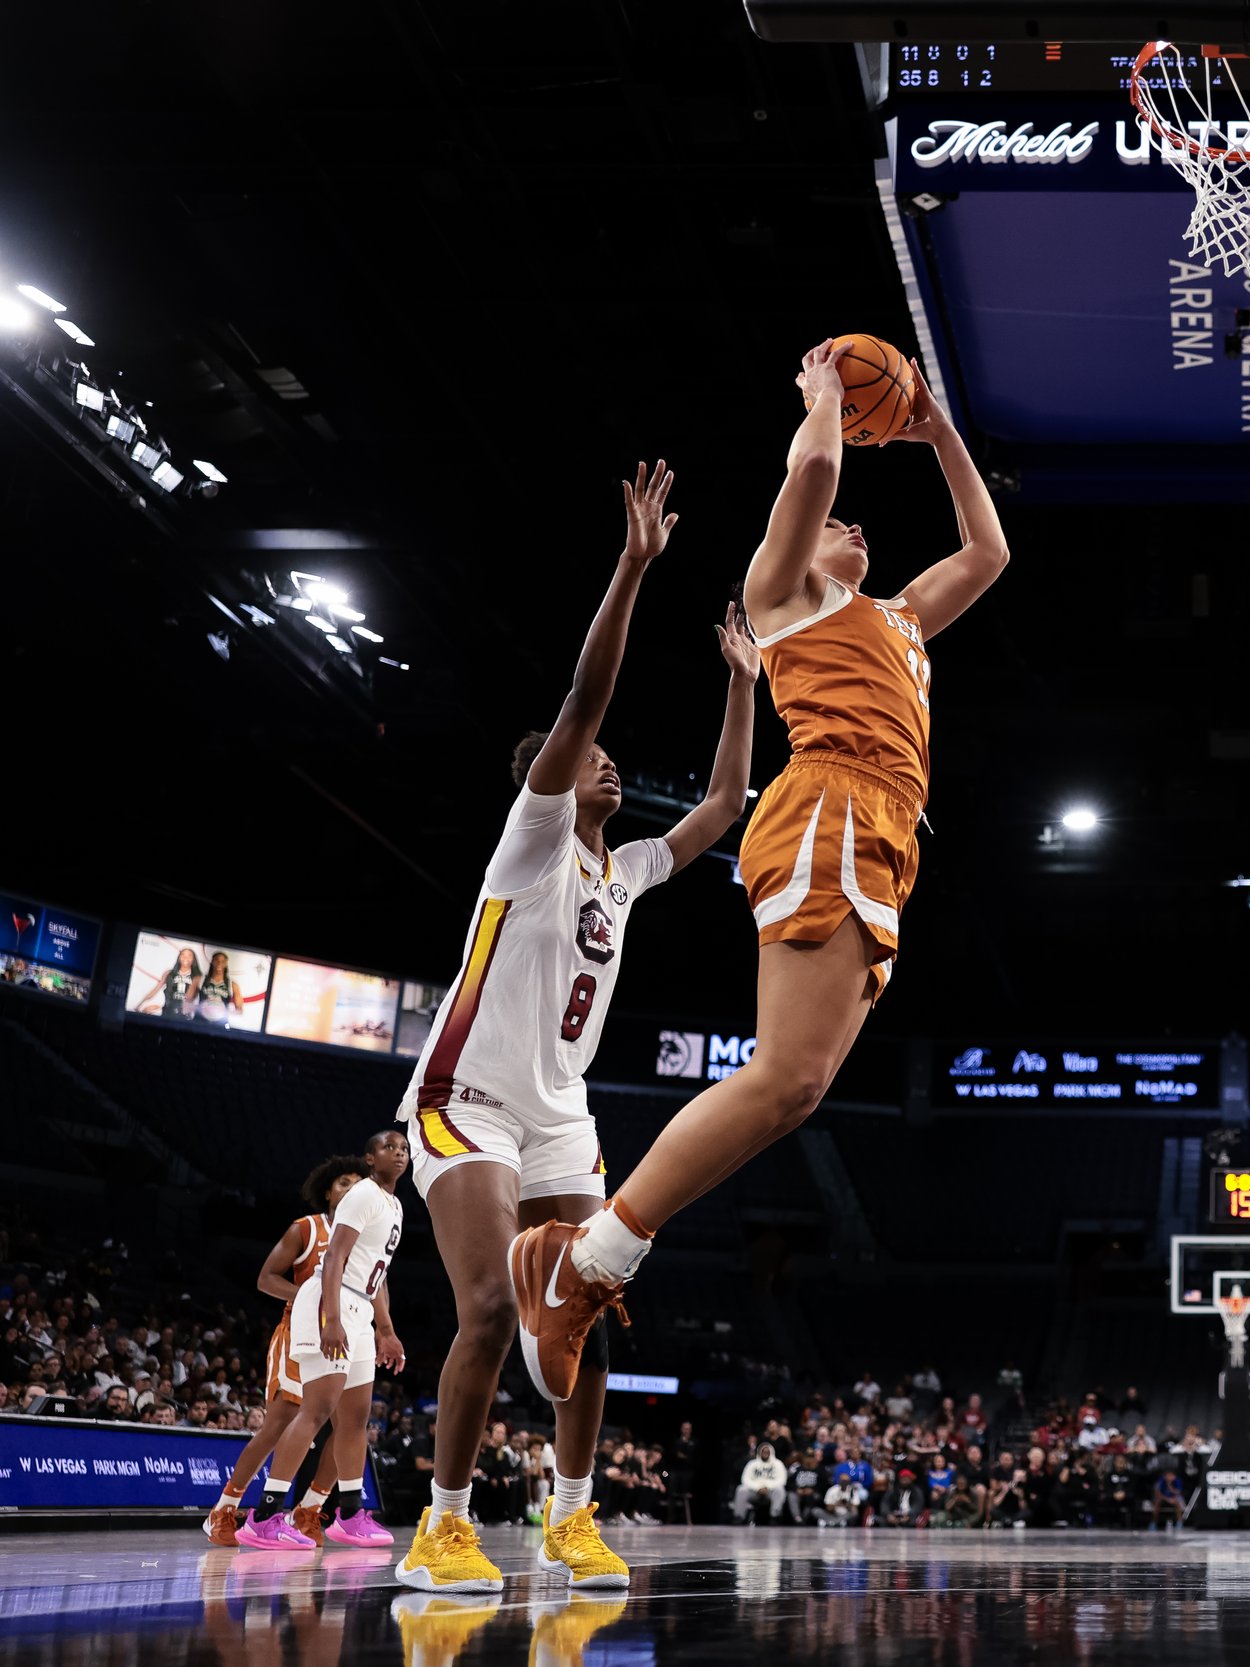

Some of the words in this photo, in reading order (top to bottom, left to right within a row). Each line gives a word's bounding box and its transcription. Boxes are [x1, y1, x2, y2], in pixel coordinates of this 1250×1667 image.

[900, 69, 922, 87] 35
[928, 69, 939, 87] 8
[980, 70, 992, 87] 2
[911, 119, 1099, 165] Michelob
[1168, 258, 1214, 370] ARENA
[610, 884, 628, 905] SEC
[560, 972, 597, 1043] 8
[460, 1087, 471, 1102] 4
[473, 1088, 487, 1099] THE
[471, 1096, 505, 1108] CULTURE
[20, 1456, 31, 1472] W
[35, 1457, 55, 1474] LAS
[54, 1457, 87, 1475] VEGAS
[93, 1459, 118, 1476] PARK
[116, 1460, 141, 1477] MGM
